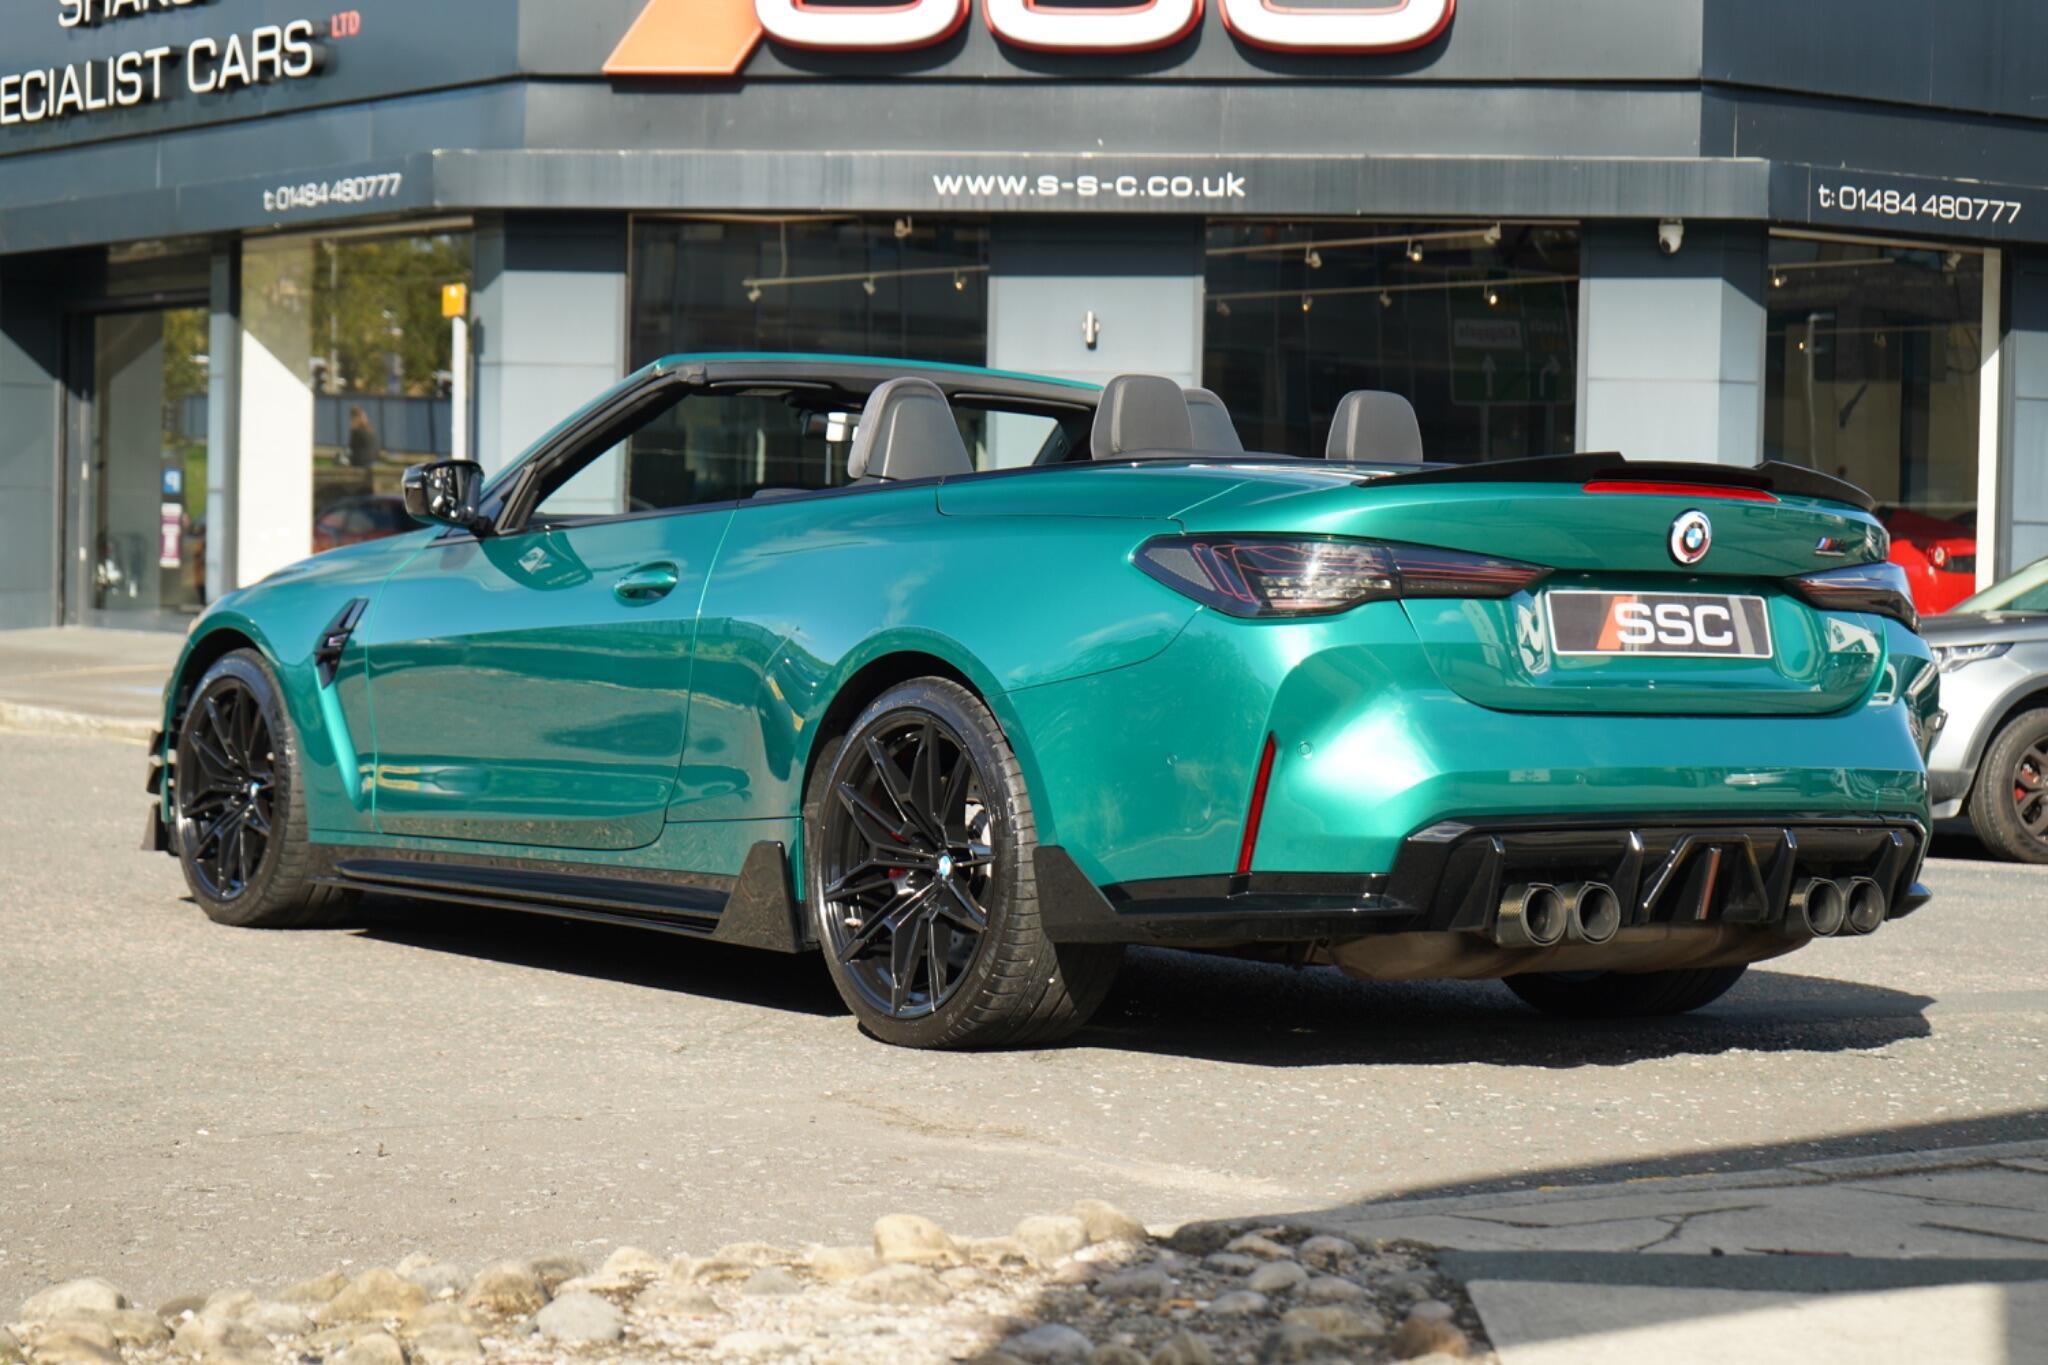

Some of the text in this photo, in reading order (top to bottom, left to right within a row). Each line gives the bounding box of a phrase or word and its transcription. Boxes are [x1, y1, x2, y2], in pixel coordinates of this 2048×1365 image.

[187, 19, 314, 93] CARS
[330, 10, 361, 38] LTD
[932, 171, 1246, 198] www.s-s-c.co.uk
[1921, 194, 2022, 224] 480777
[1614, 602, 1734, 647] SSC
